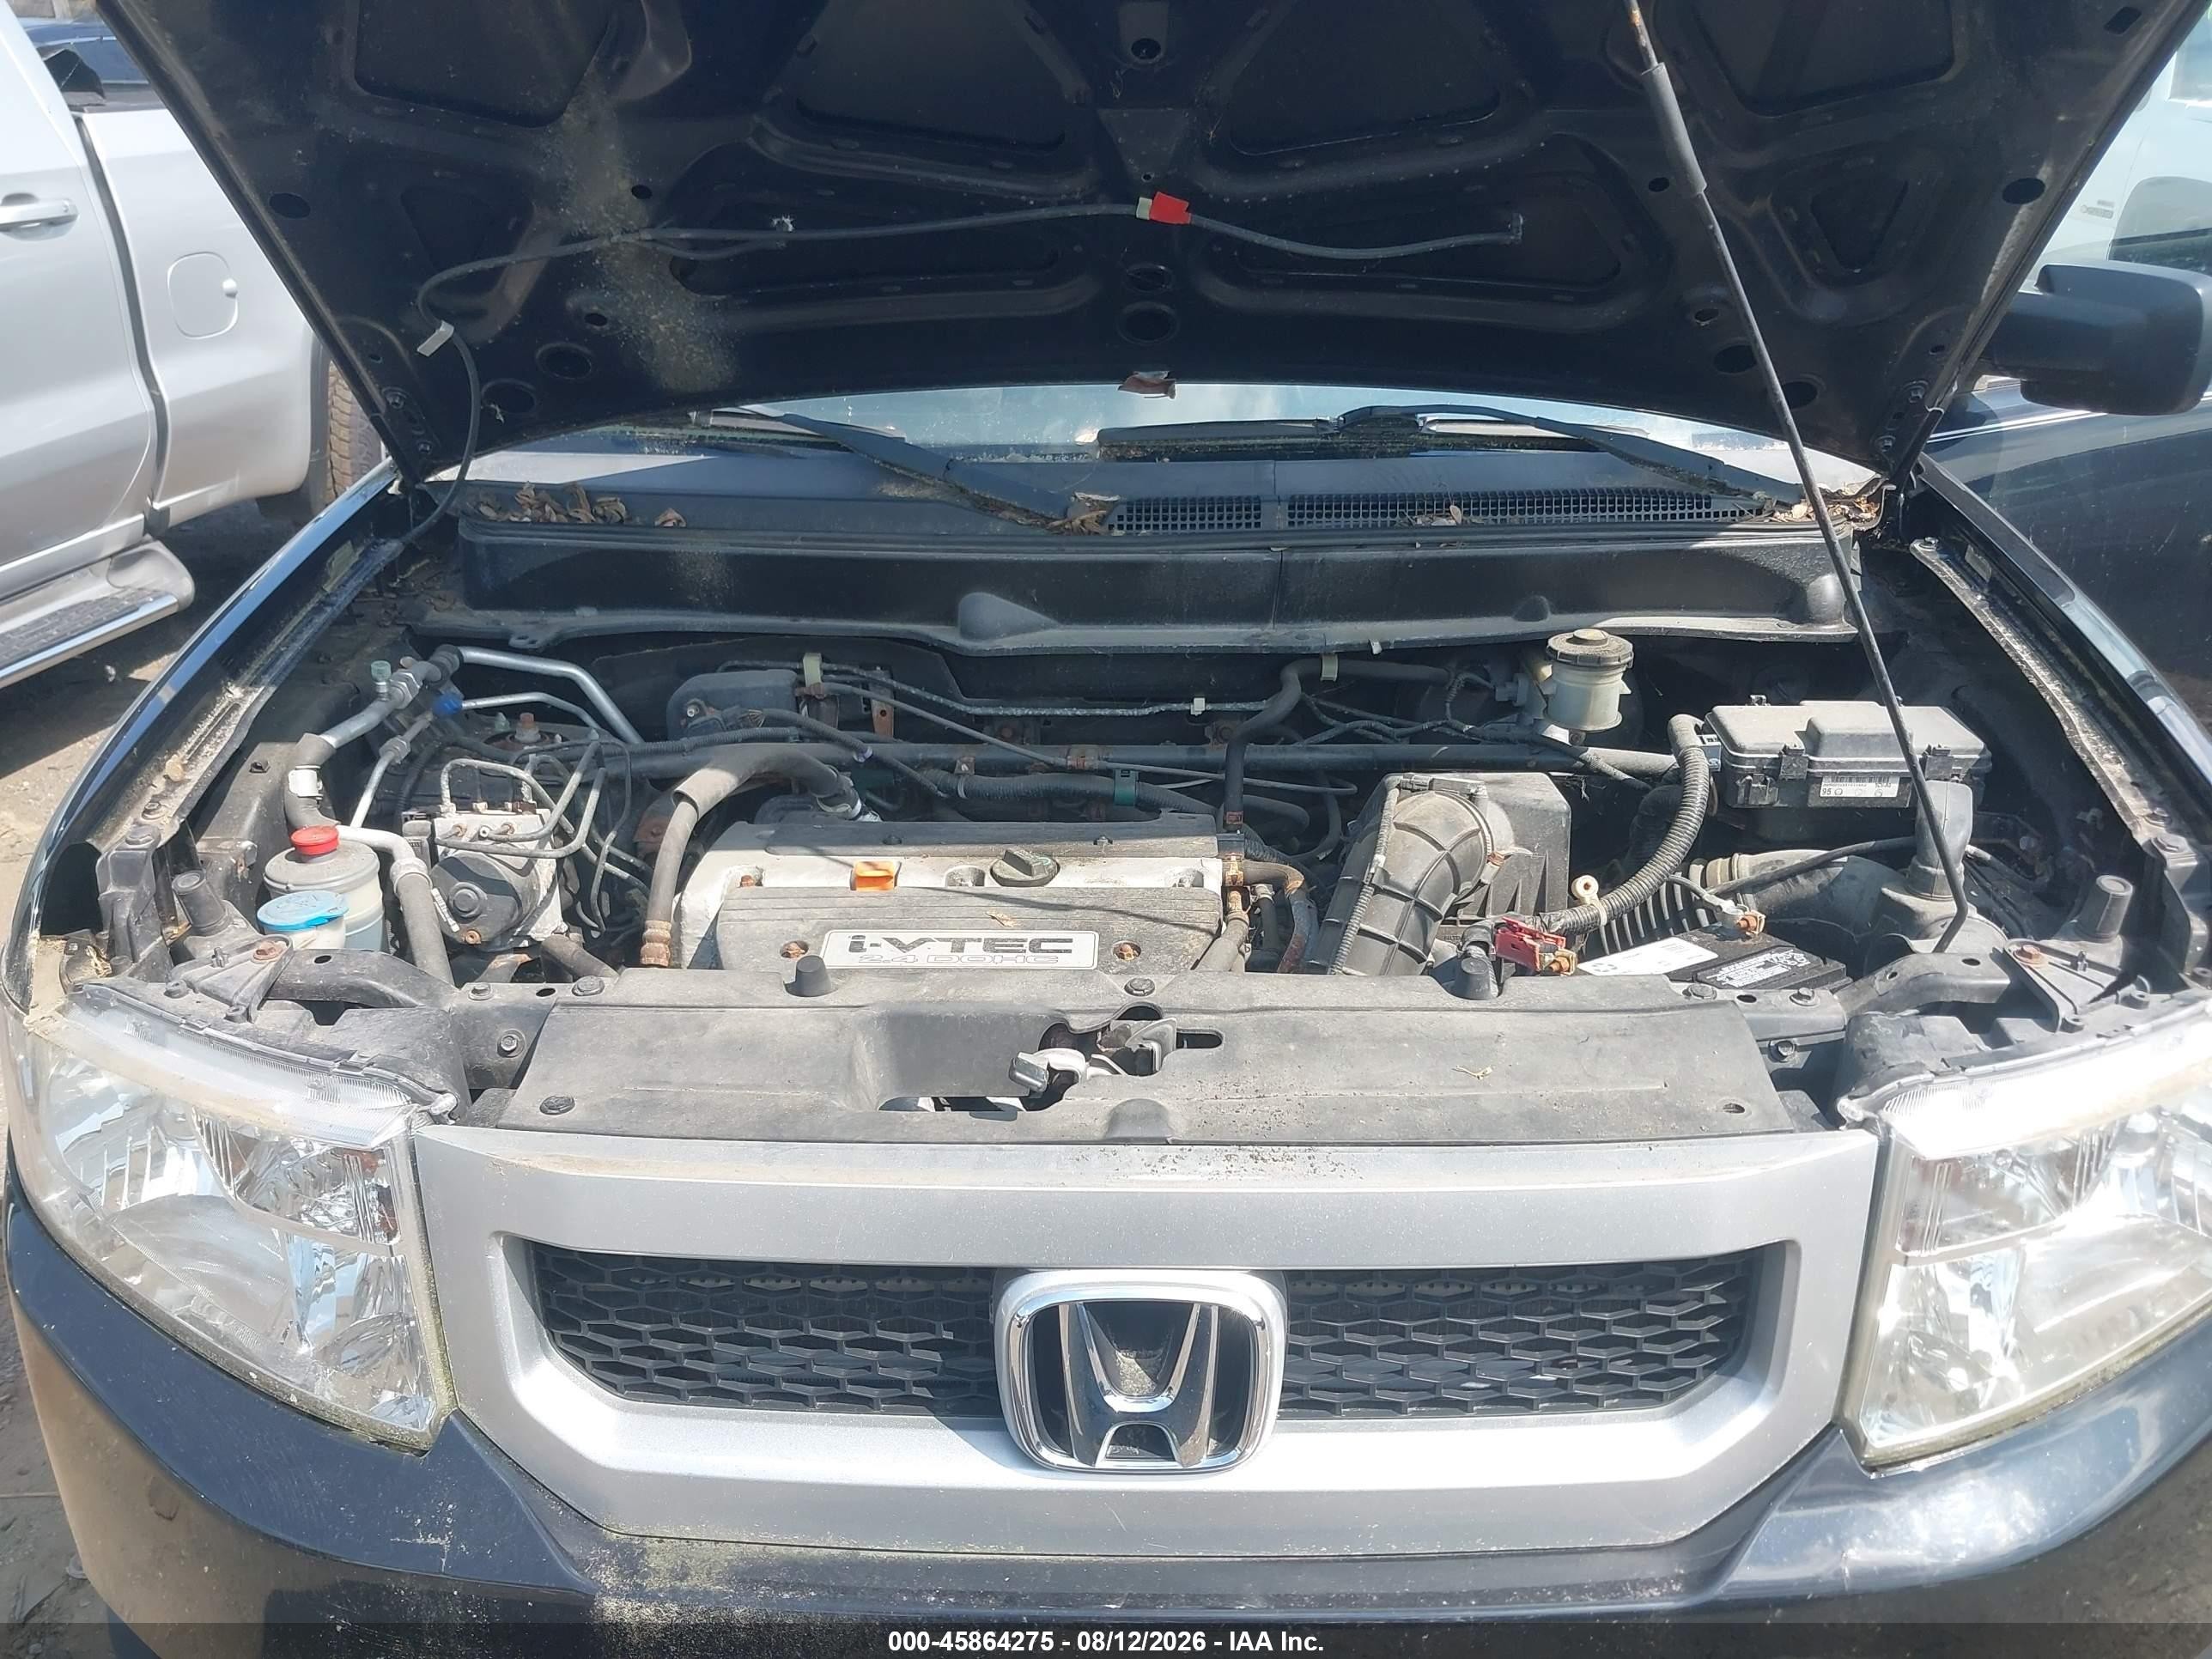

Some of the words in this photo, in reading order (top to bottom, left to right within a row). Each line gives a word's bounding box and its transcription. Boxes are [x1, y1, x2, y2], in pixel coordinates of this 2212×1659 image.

[848, 934, 1073, 954] i-VTEC
[859, 954, 918, 963] 2.4
[927, 954, 1060, 964] DOHC
